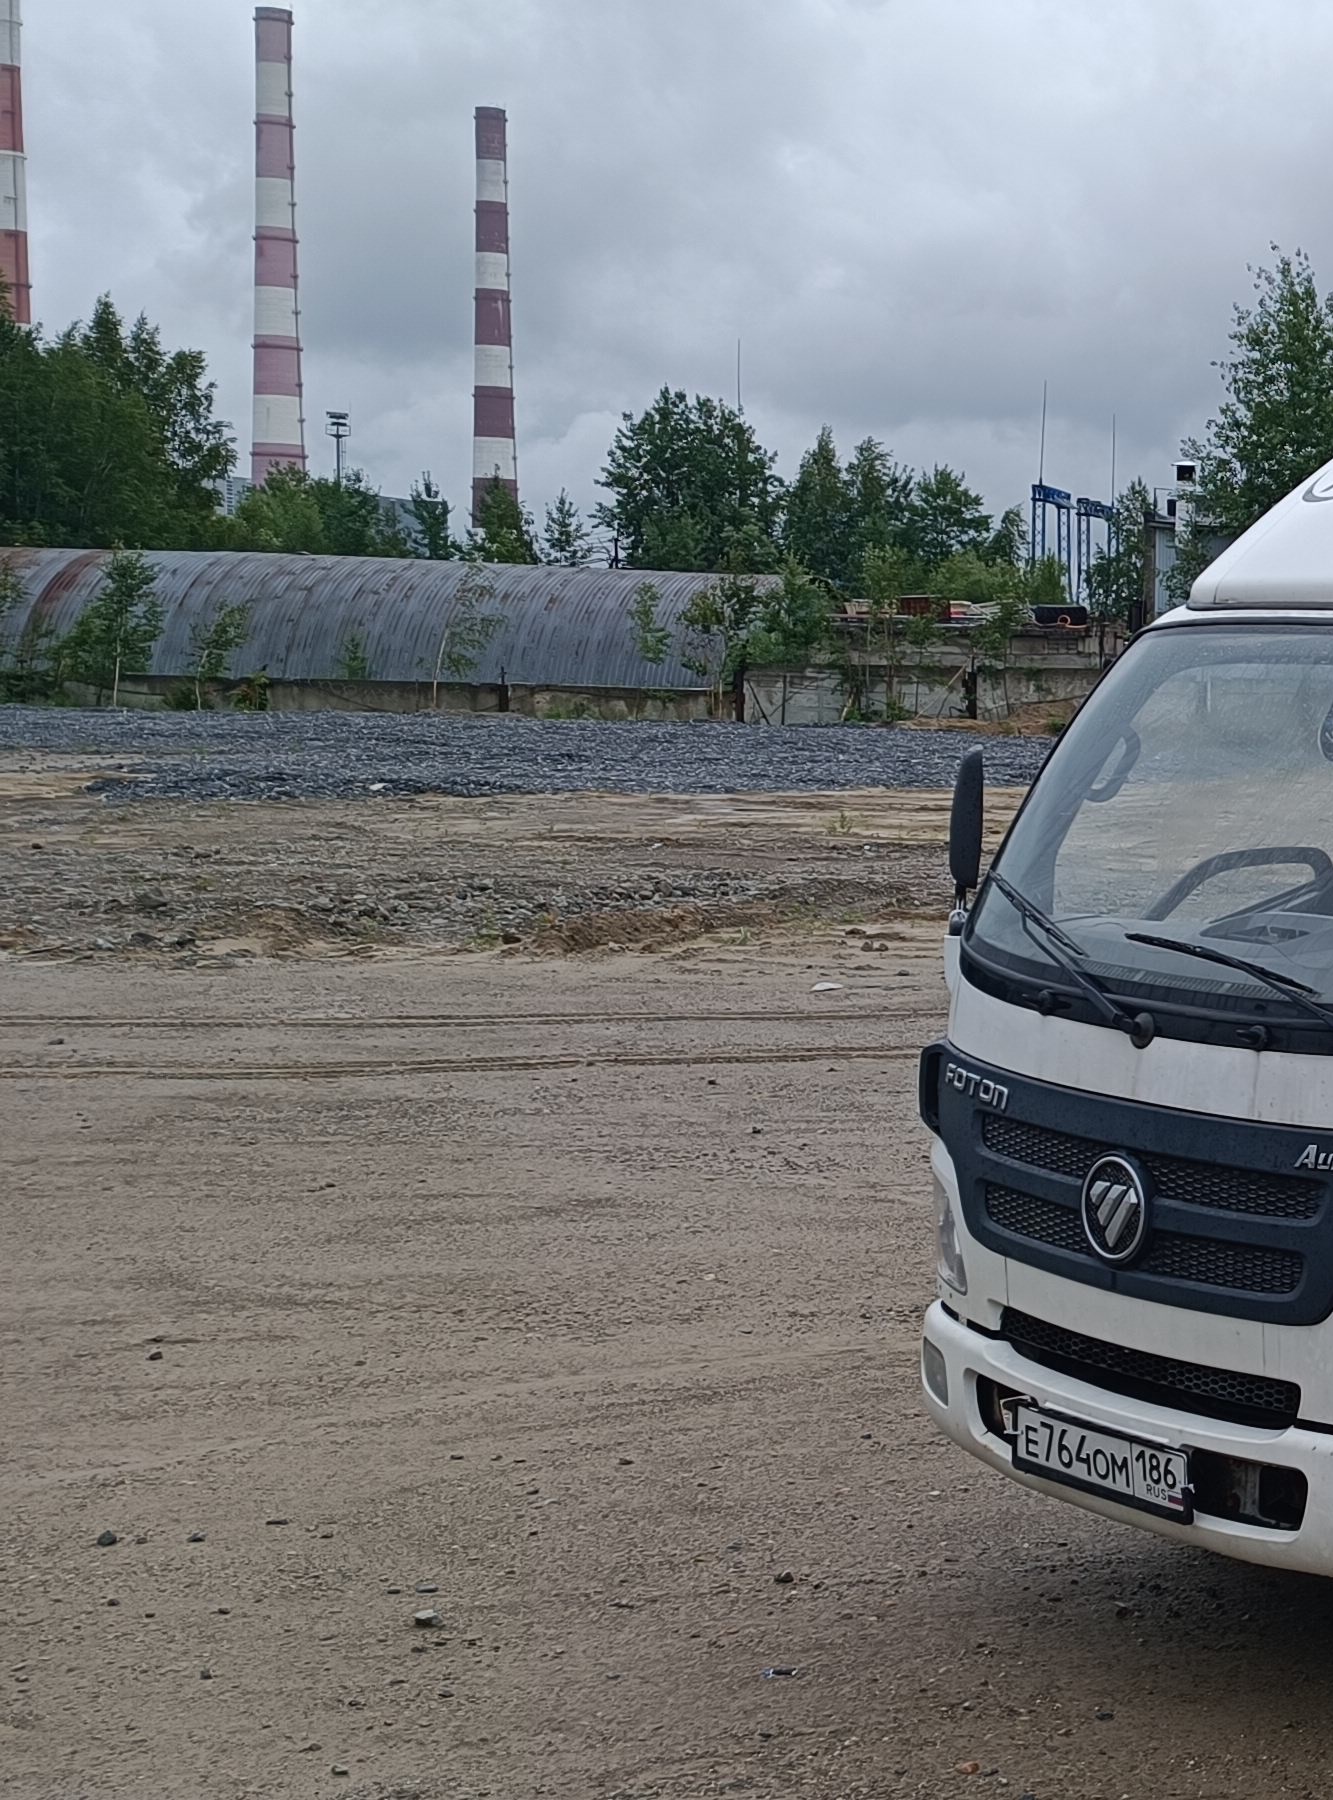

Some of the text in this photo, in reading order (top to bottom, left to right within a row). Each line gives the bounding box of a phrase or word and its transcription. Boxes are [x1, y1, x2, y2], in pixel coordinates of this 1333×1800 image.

[945, 1062, 1008, 1112] FOTON
[1135, 1449, 1177, 1490] 186
[1146, 1484, 1167, 1501] RUS
